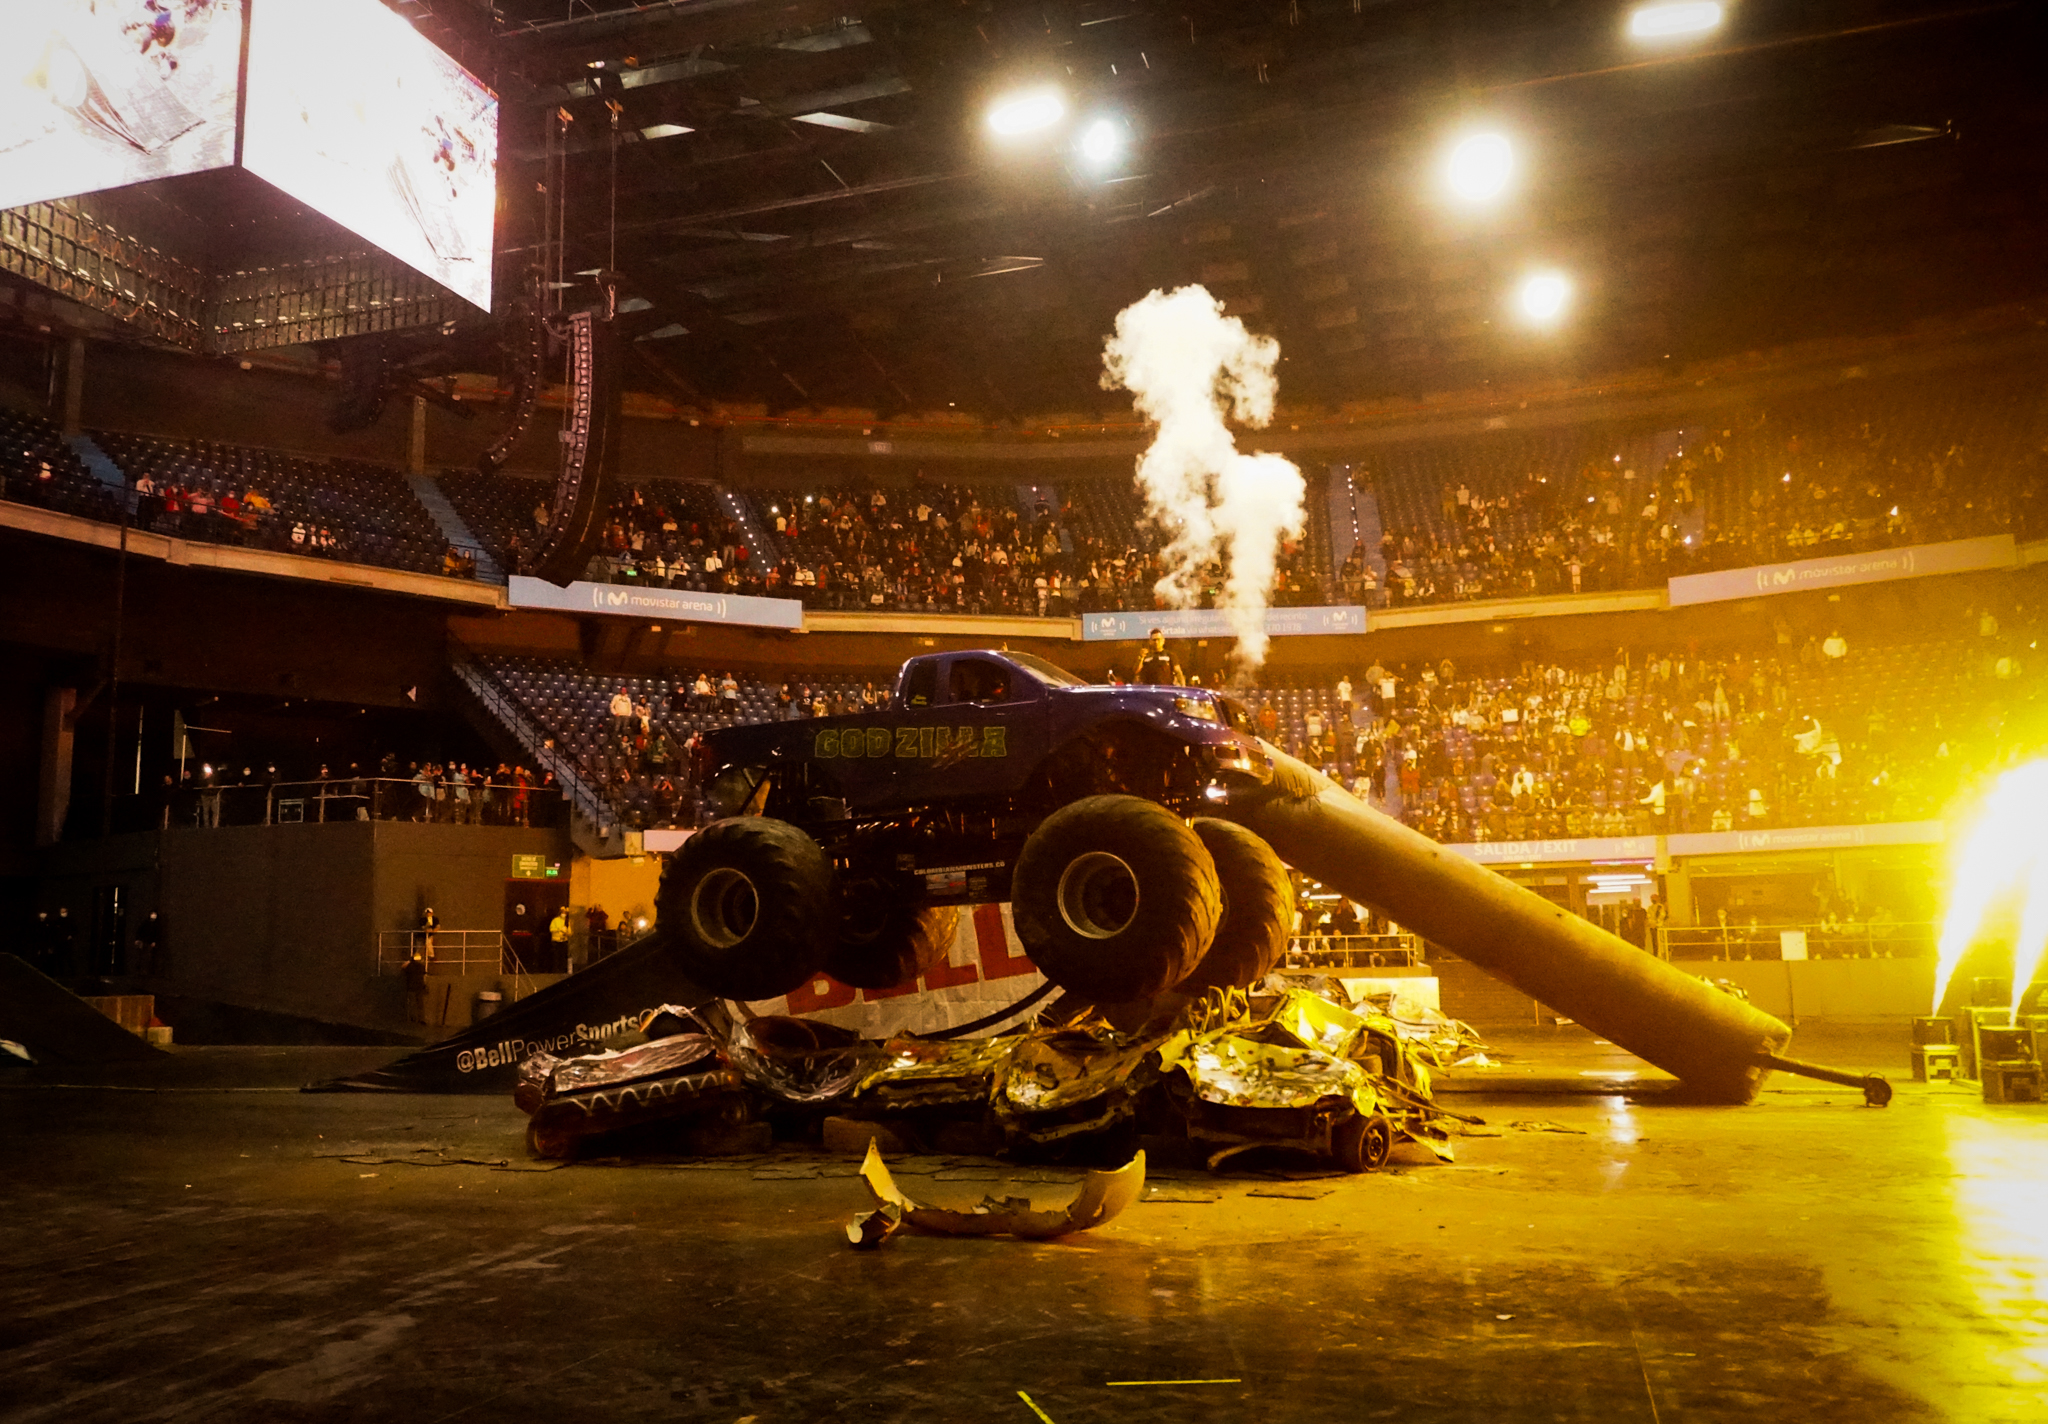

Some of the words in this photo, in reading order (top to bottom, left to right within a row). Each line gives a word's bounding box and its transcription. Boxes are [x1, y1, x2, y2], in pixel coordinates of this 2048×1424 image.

[1799, 565, 1857, 579] movistar
[1860, 560, 1897, 571] arena
[631, 596, 680, 609] movistar
[682, 601, 713, 611] arena
[814, 726, 1007, 758] GODZILLA
[1474, 843, 1530, 856] SALIDA
[1544, 839, 1577, 854] EXIT
